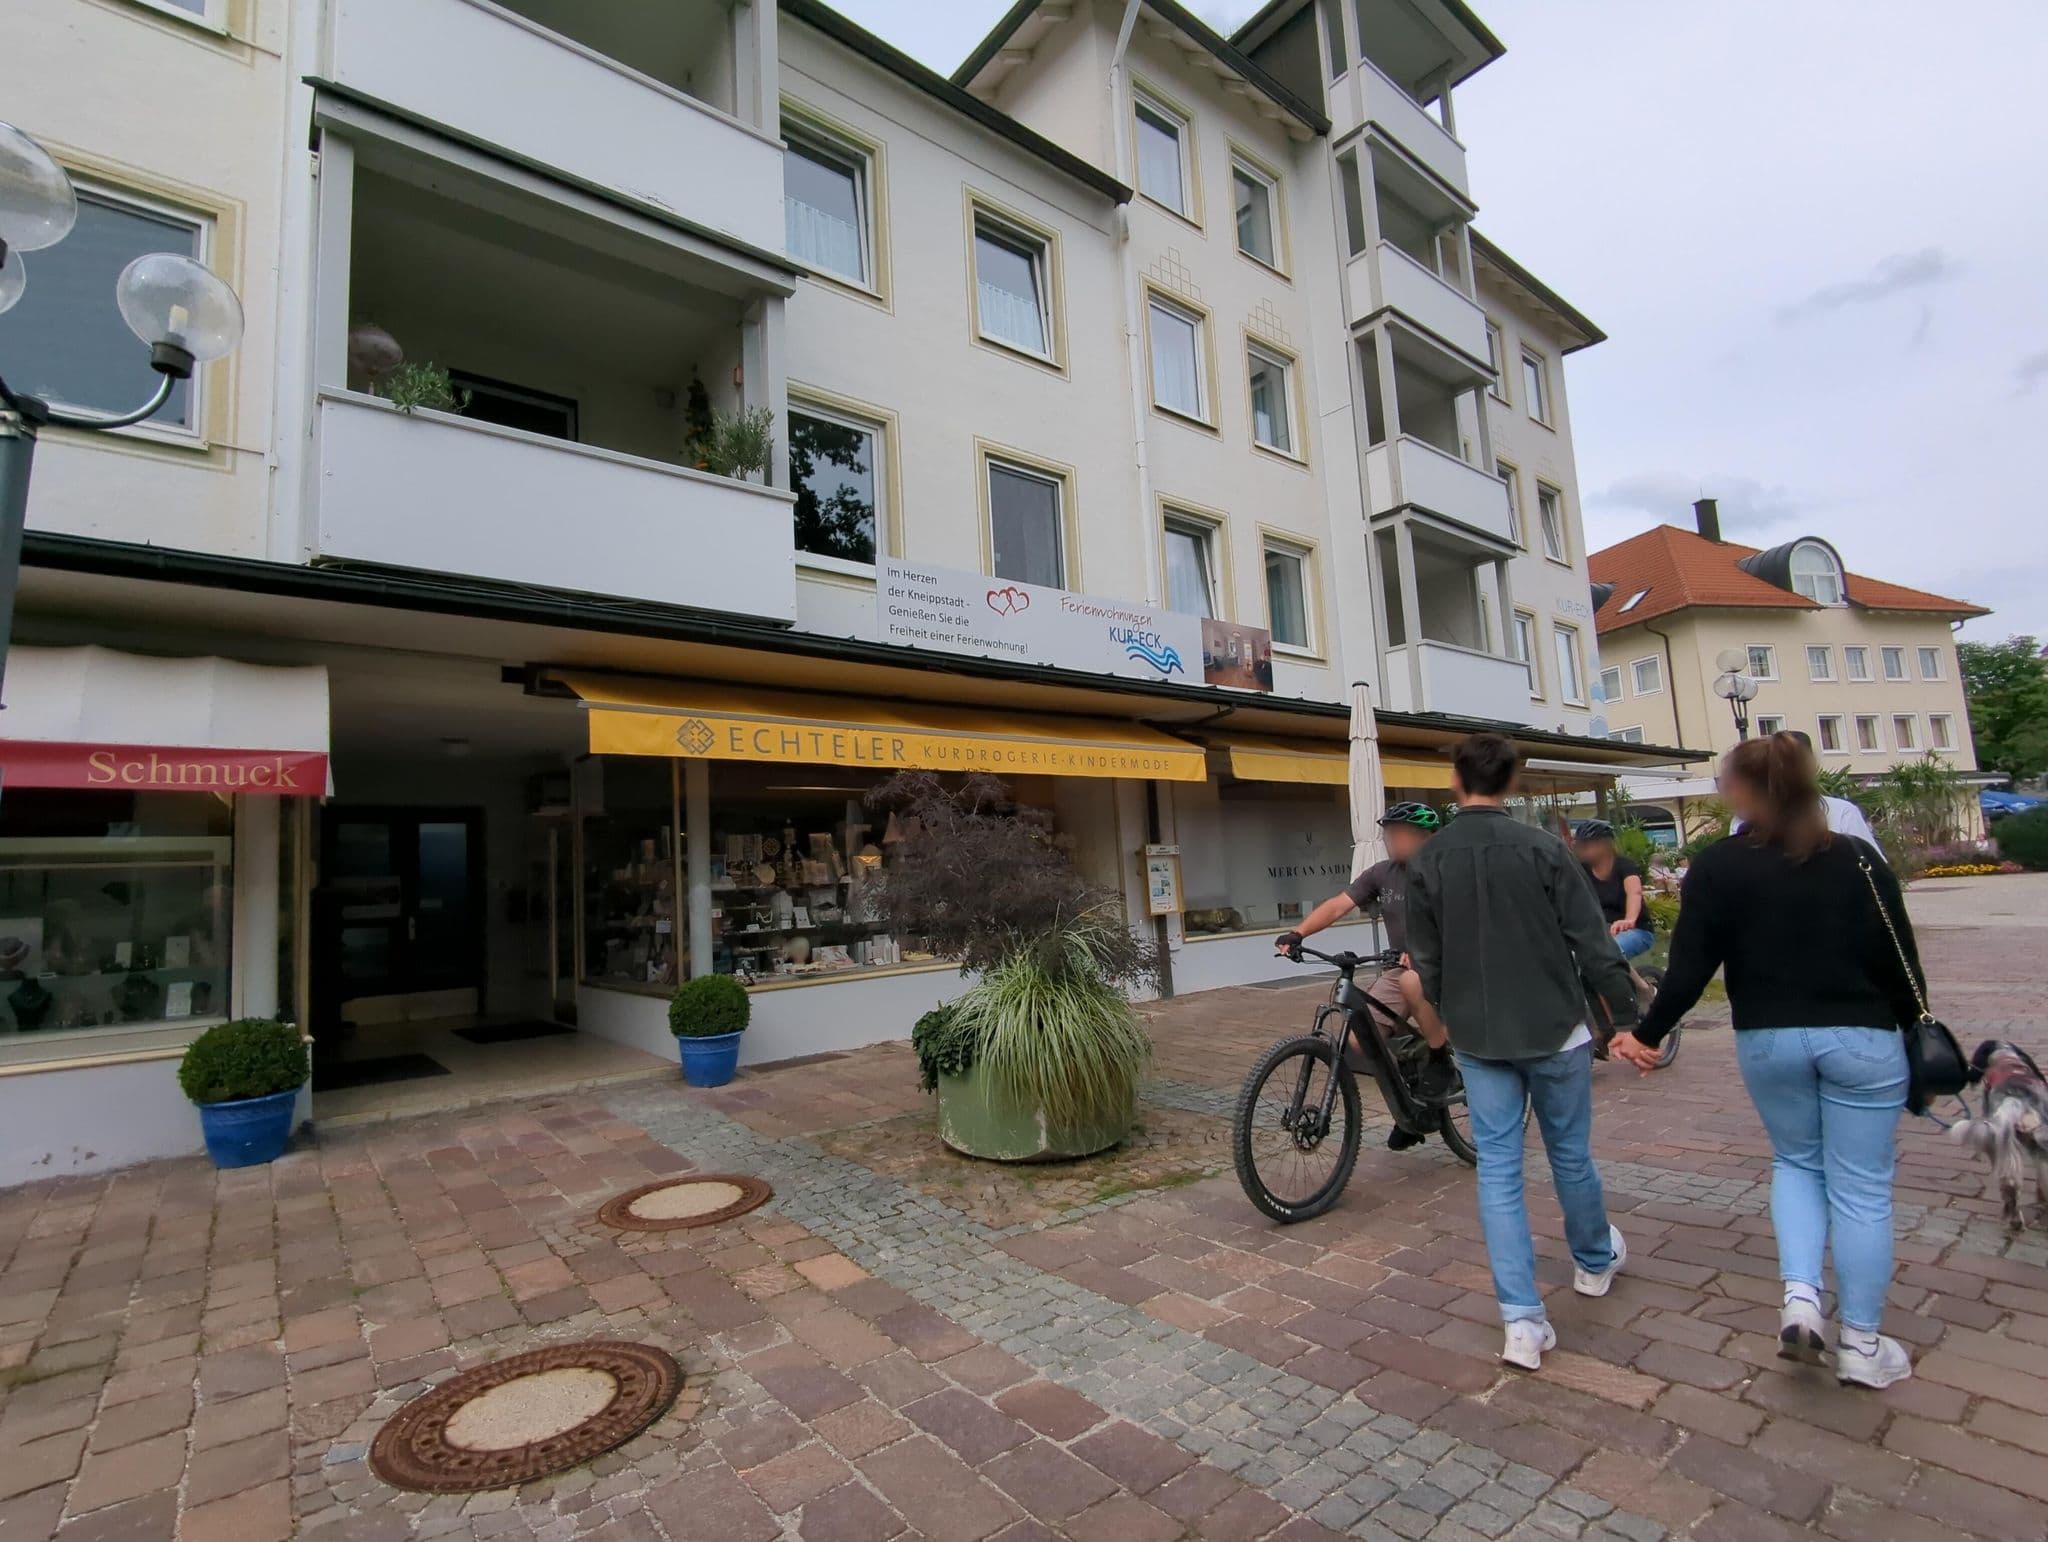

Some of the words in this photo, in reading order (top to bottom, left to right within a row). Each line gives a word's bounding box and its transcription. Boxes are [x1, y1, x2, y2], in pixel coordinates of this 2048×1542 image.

[887, 567, 900, 579] Im
[903, 569, 938, 585] Herzen
[888, 586, 905, 597] der
[908, 588, 965, 608] Kneippstadt
[888, 605, 936, 622] Genießen
[939, 612, 953, 625] Sie
[955, 616, 969, 627] die
[1060, 596, 1152, 633] Ferienwohnungen
[889, 624, 928, 640] Freiheit
[930, 631, 954, 643] einer
[957, 634, 1028, 654] Ferienwohnung!
[728, 726, 906, 762] ECHTELER
[923, 745, 1057, 764] KURDROGERIE
[1068, 754, 1169, 770] KINDERMODE
[87, 751, 298, 788] Schmuck
